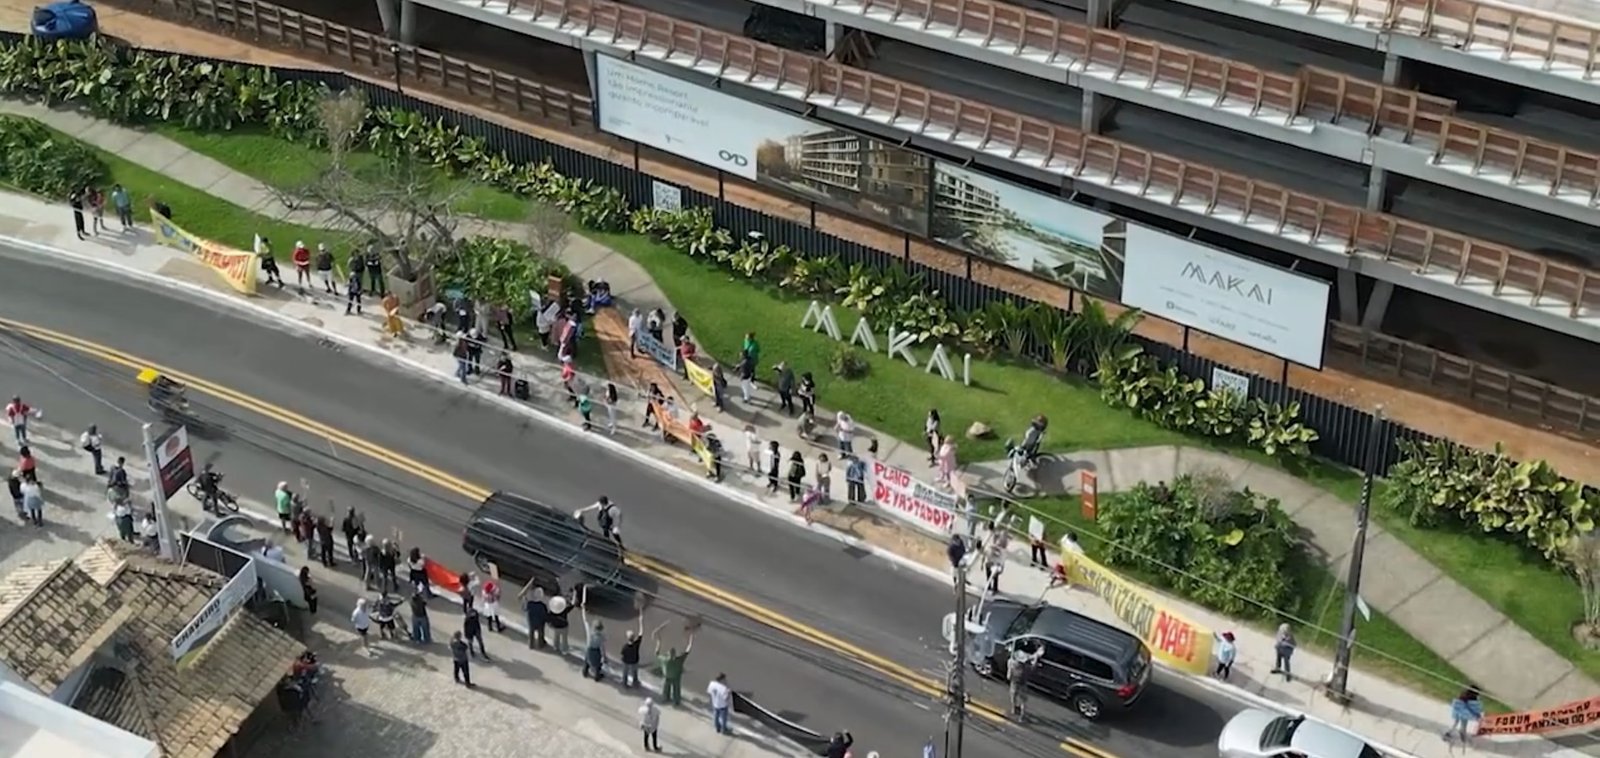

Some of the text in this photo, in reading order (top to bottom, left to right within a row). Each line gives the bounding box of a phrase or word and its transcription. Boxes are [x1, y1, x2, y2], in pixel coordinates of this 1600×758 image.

[1181, 261, 1272, 305] MAKAI
[801, 300, 971, 386] MAKAI
[875, 462, 910, 488] PLANO
[175, 599, 220, 649] CHAVEIRO
